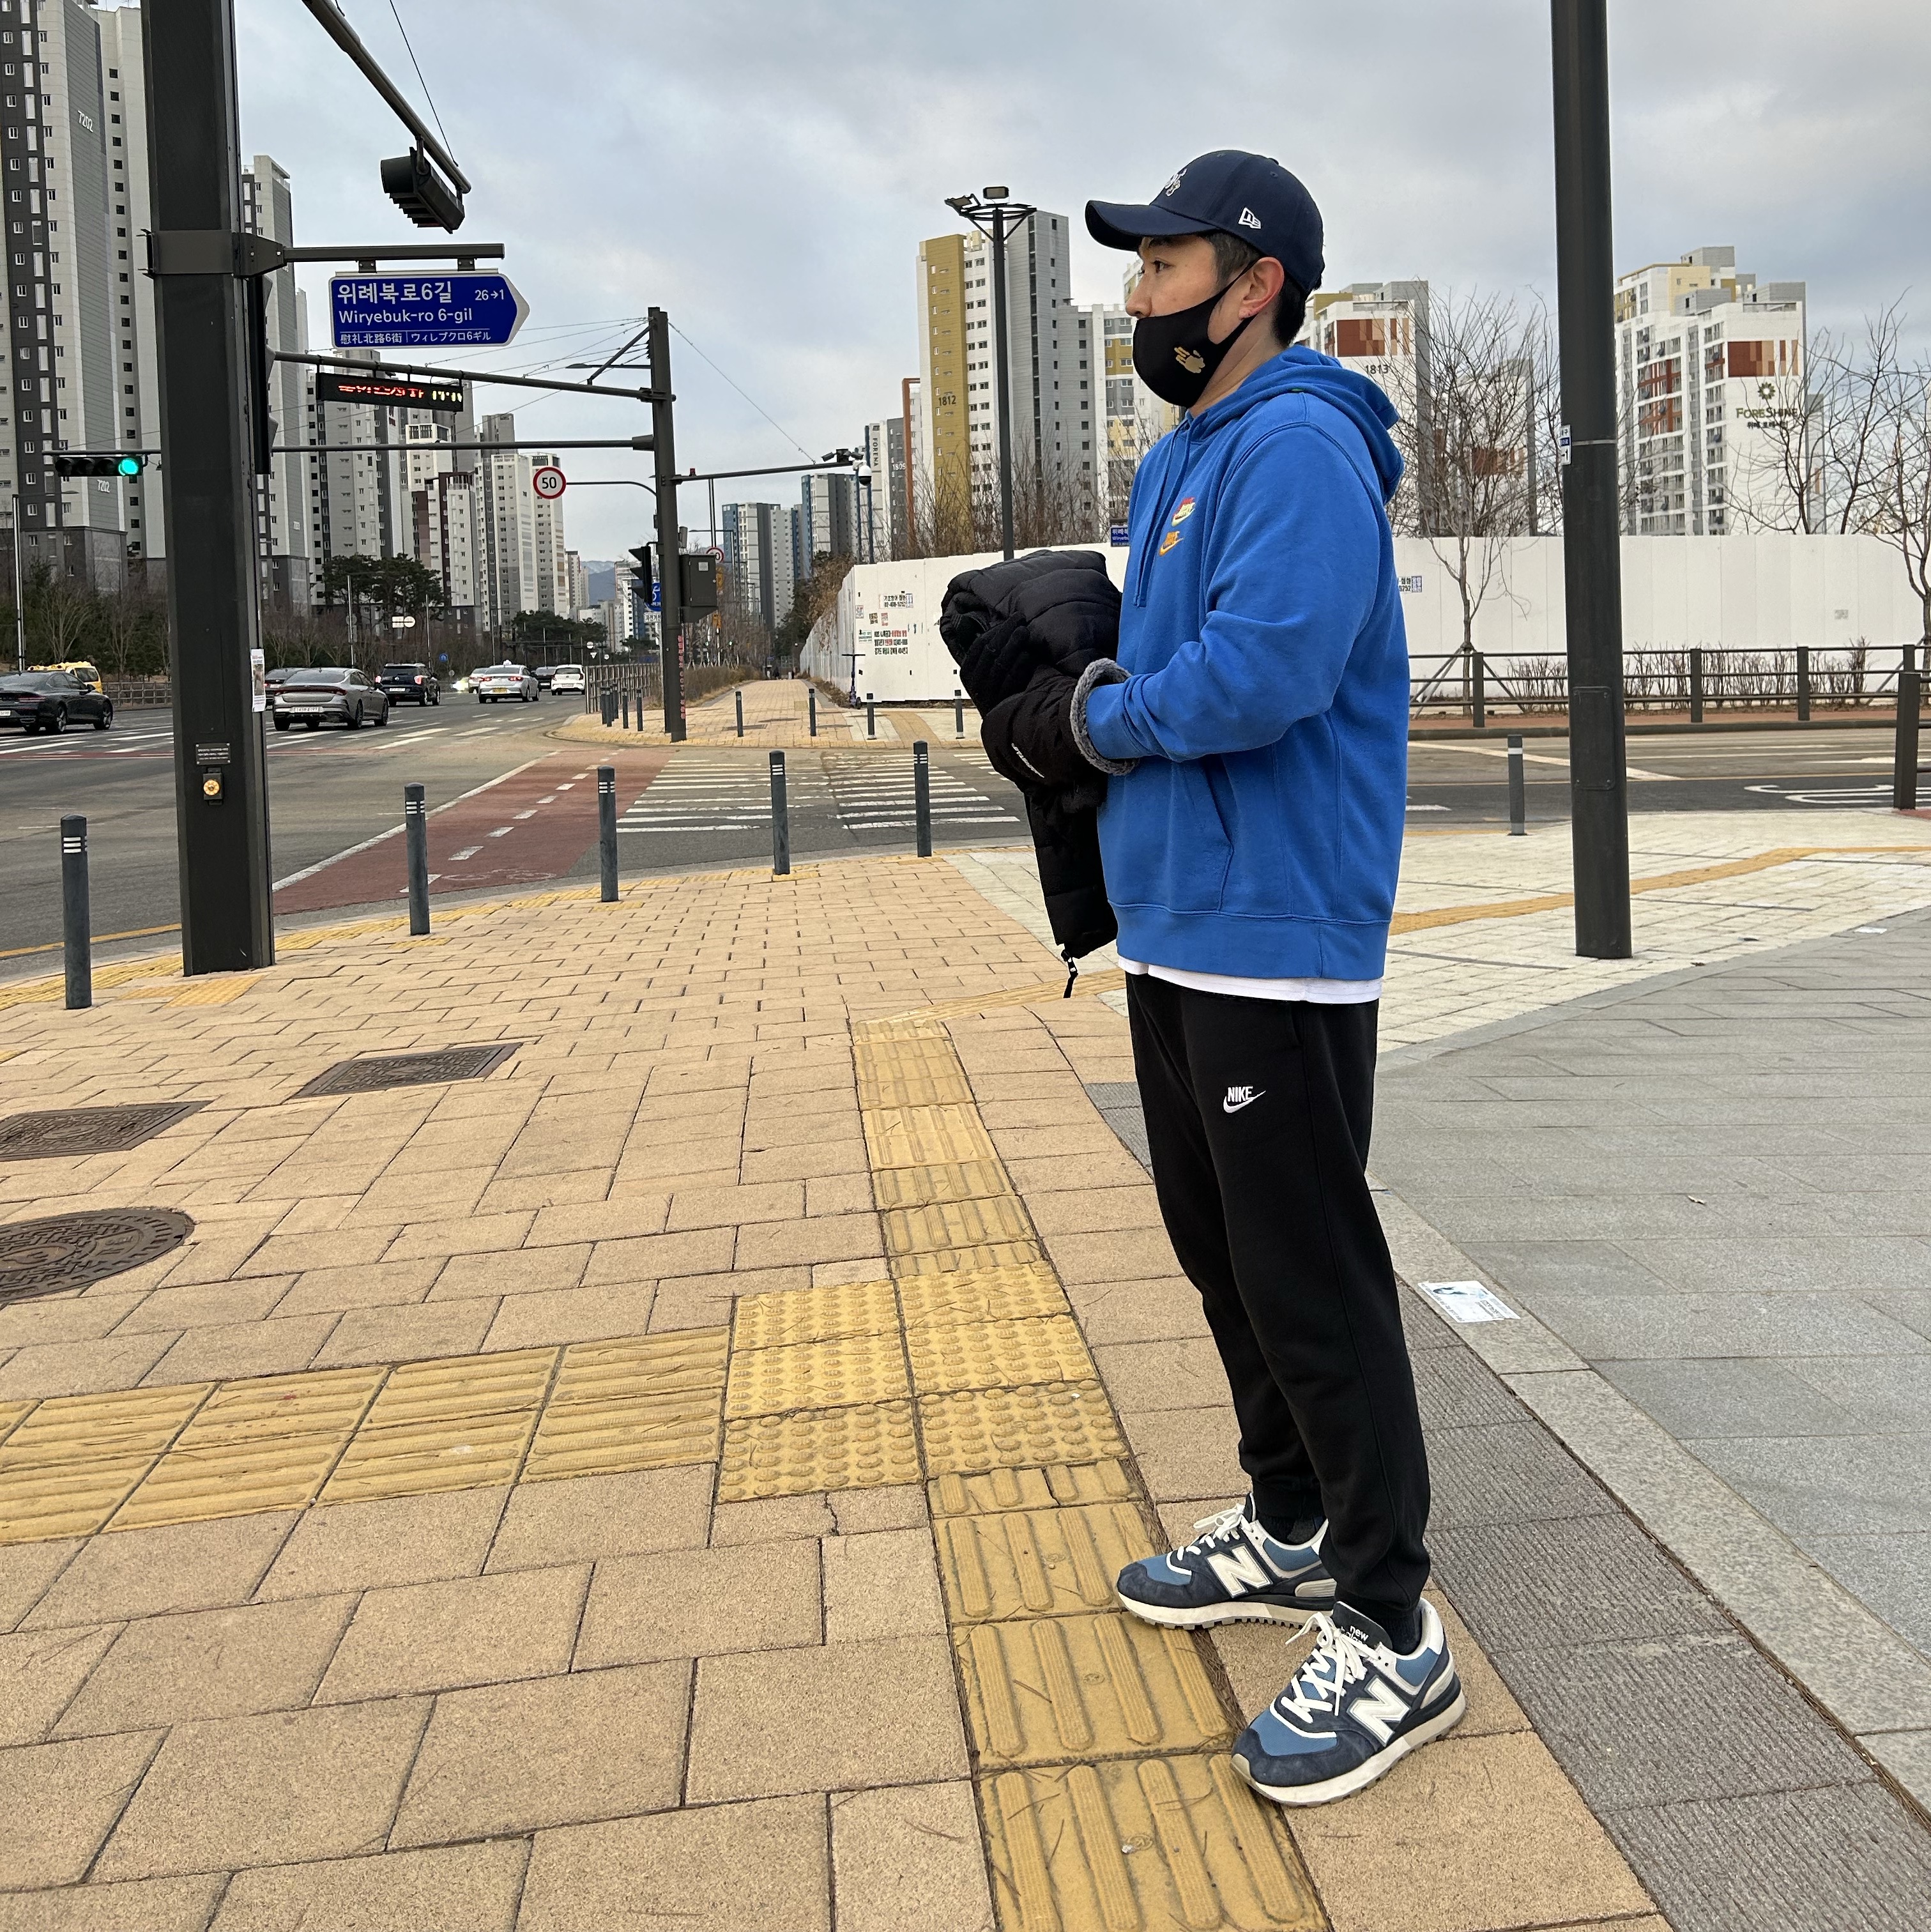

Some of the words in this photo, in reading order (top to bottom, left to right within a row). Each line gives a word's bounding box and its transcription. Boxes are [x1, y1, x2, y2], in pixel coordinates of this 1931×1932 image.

[77, 110, 94, 132] 7202
[337, 281, 452, 304] 위례북로6길
[339, 309, 434, 326] Wiryebuk-ro
[438, 307, 473, 324] 6-gil
[1366, 364, 1389, 374] 1813
[938, 395, 956, 406] 1812
[542, 477, 557, 489] 50
[1227, 1085, 1254, 1103] NIKE
[1350, 1625, 1370, 1641] new
